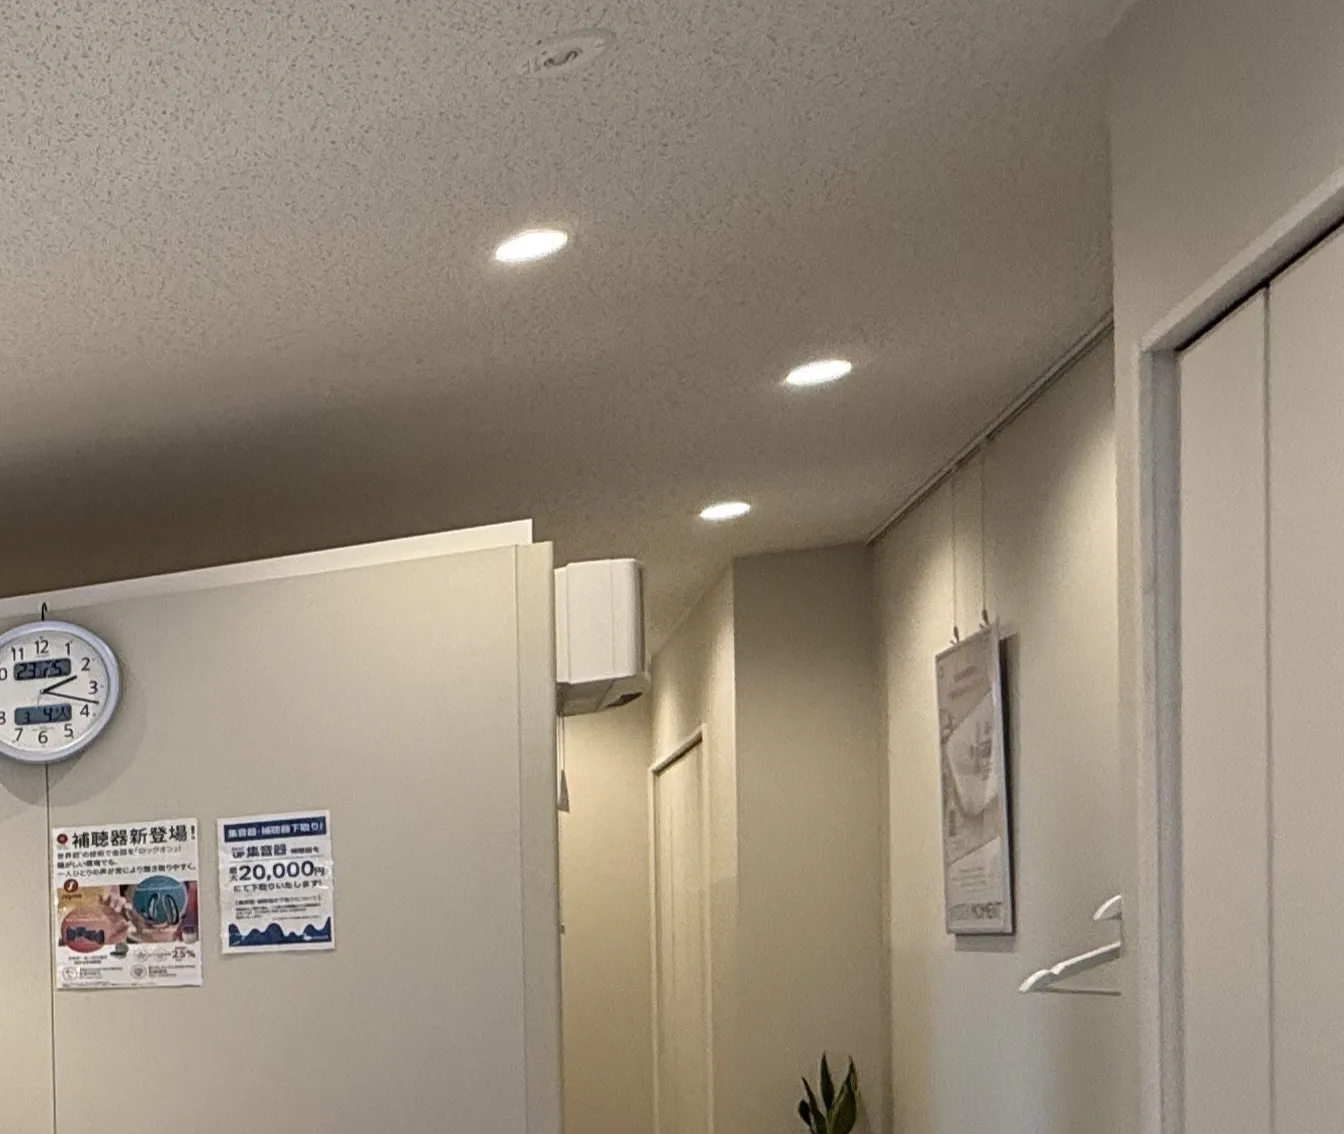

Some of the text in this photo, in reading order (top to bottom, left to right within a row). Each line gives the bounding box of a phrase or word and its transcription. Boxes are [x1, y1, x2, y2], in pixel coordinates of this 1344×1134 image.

[12, 647, 24, 661] 11
[34, 640, 49, 655] 12
[64, 642, 71, 656] 1
[81, 657, 90, 672] 2
[88, 681, 98, 695] 3
[80, 704, 90, 718] 4
[14, 728, 23, 742] 7
[38, 731, 48, 744] 6
[64, 724, 74, 738] 5
